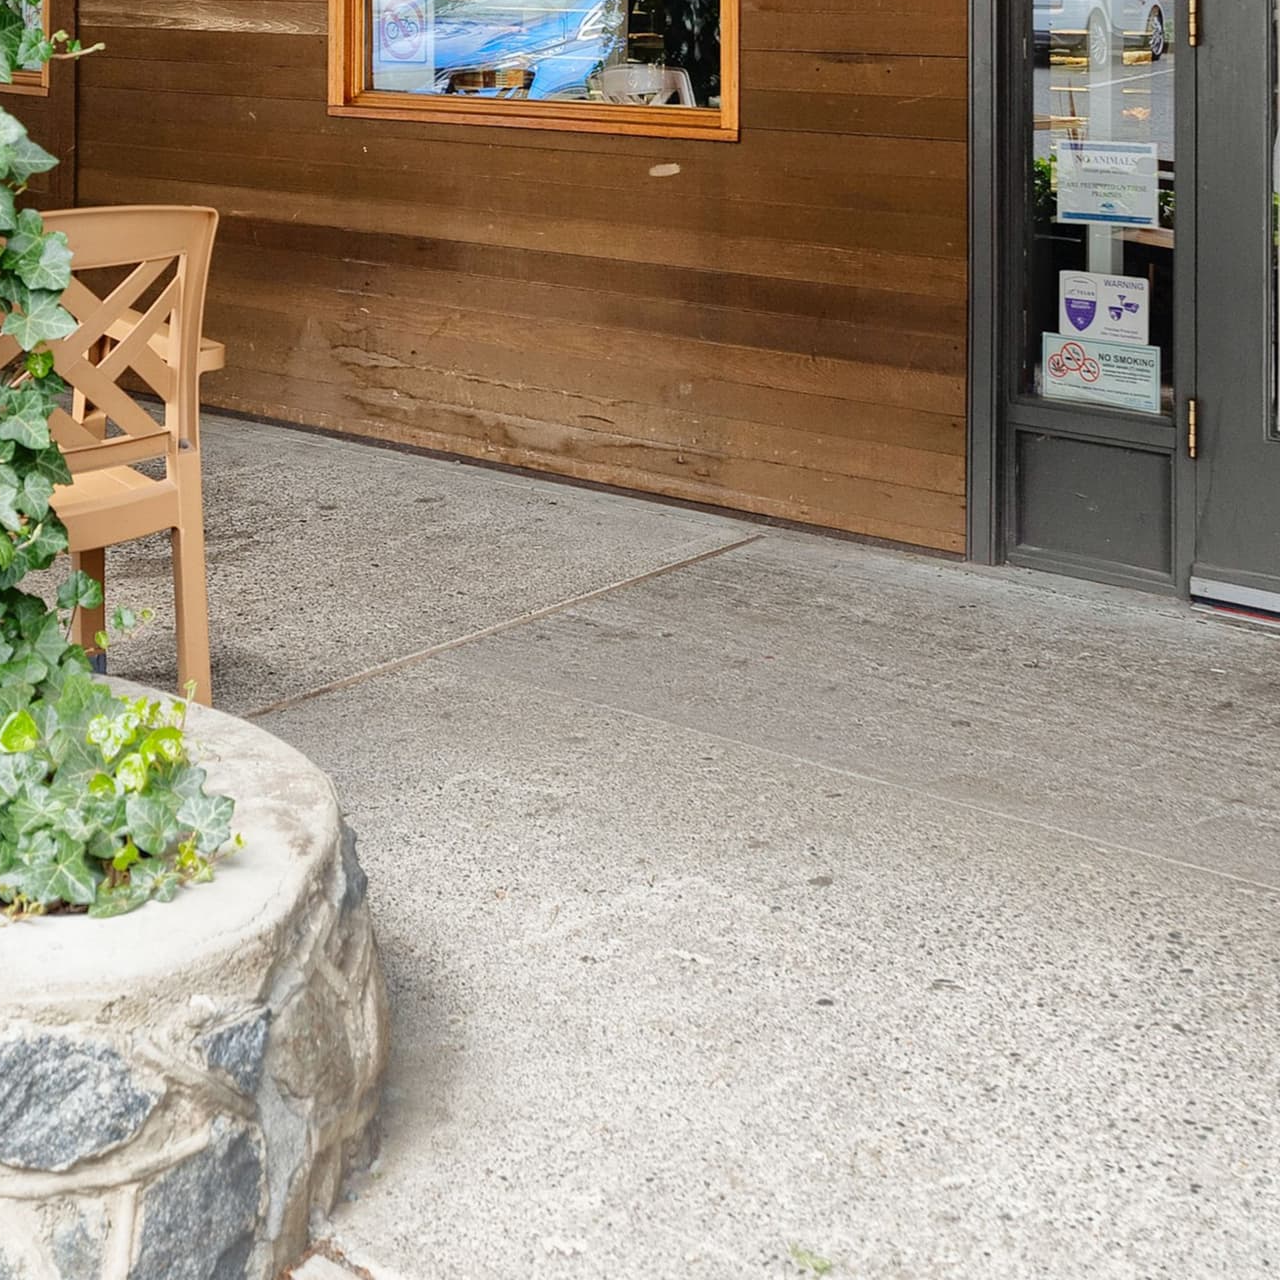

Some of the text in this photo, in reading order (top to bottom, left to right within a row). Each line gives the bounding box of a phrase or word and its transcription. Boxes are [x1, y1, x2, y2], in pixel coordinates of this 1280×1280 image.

[1094, 155, 1138, 166] ANIMALS
[1103, 279, 1145, 291] WARNING
[1098, 353, 1155, 369] NO SMOKING
